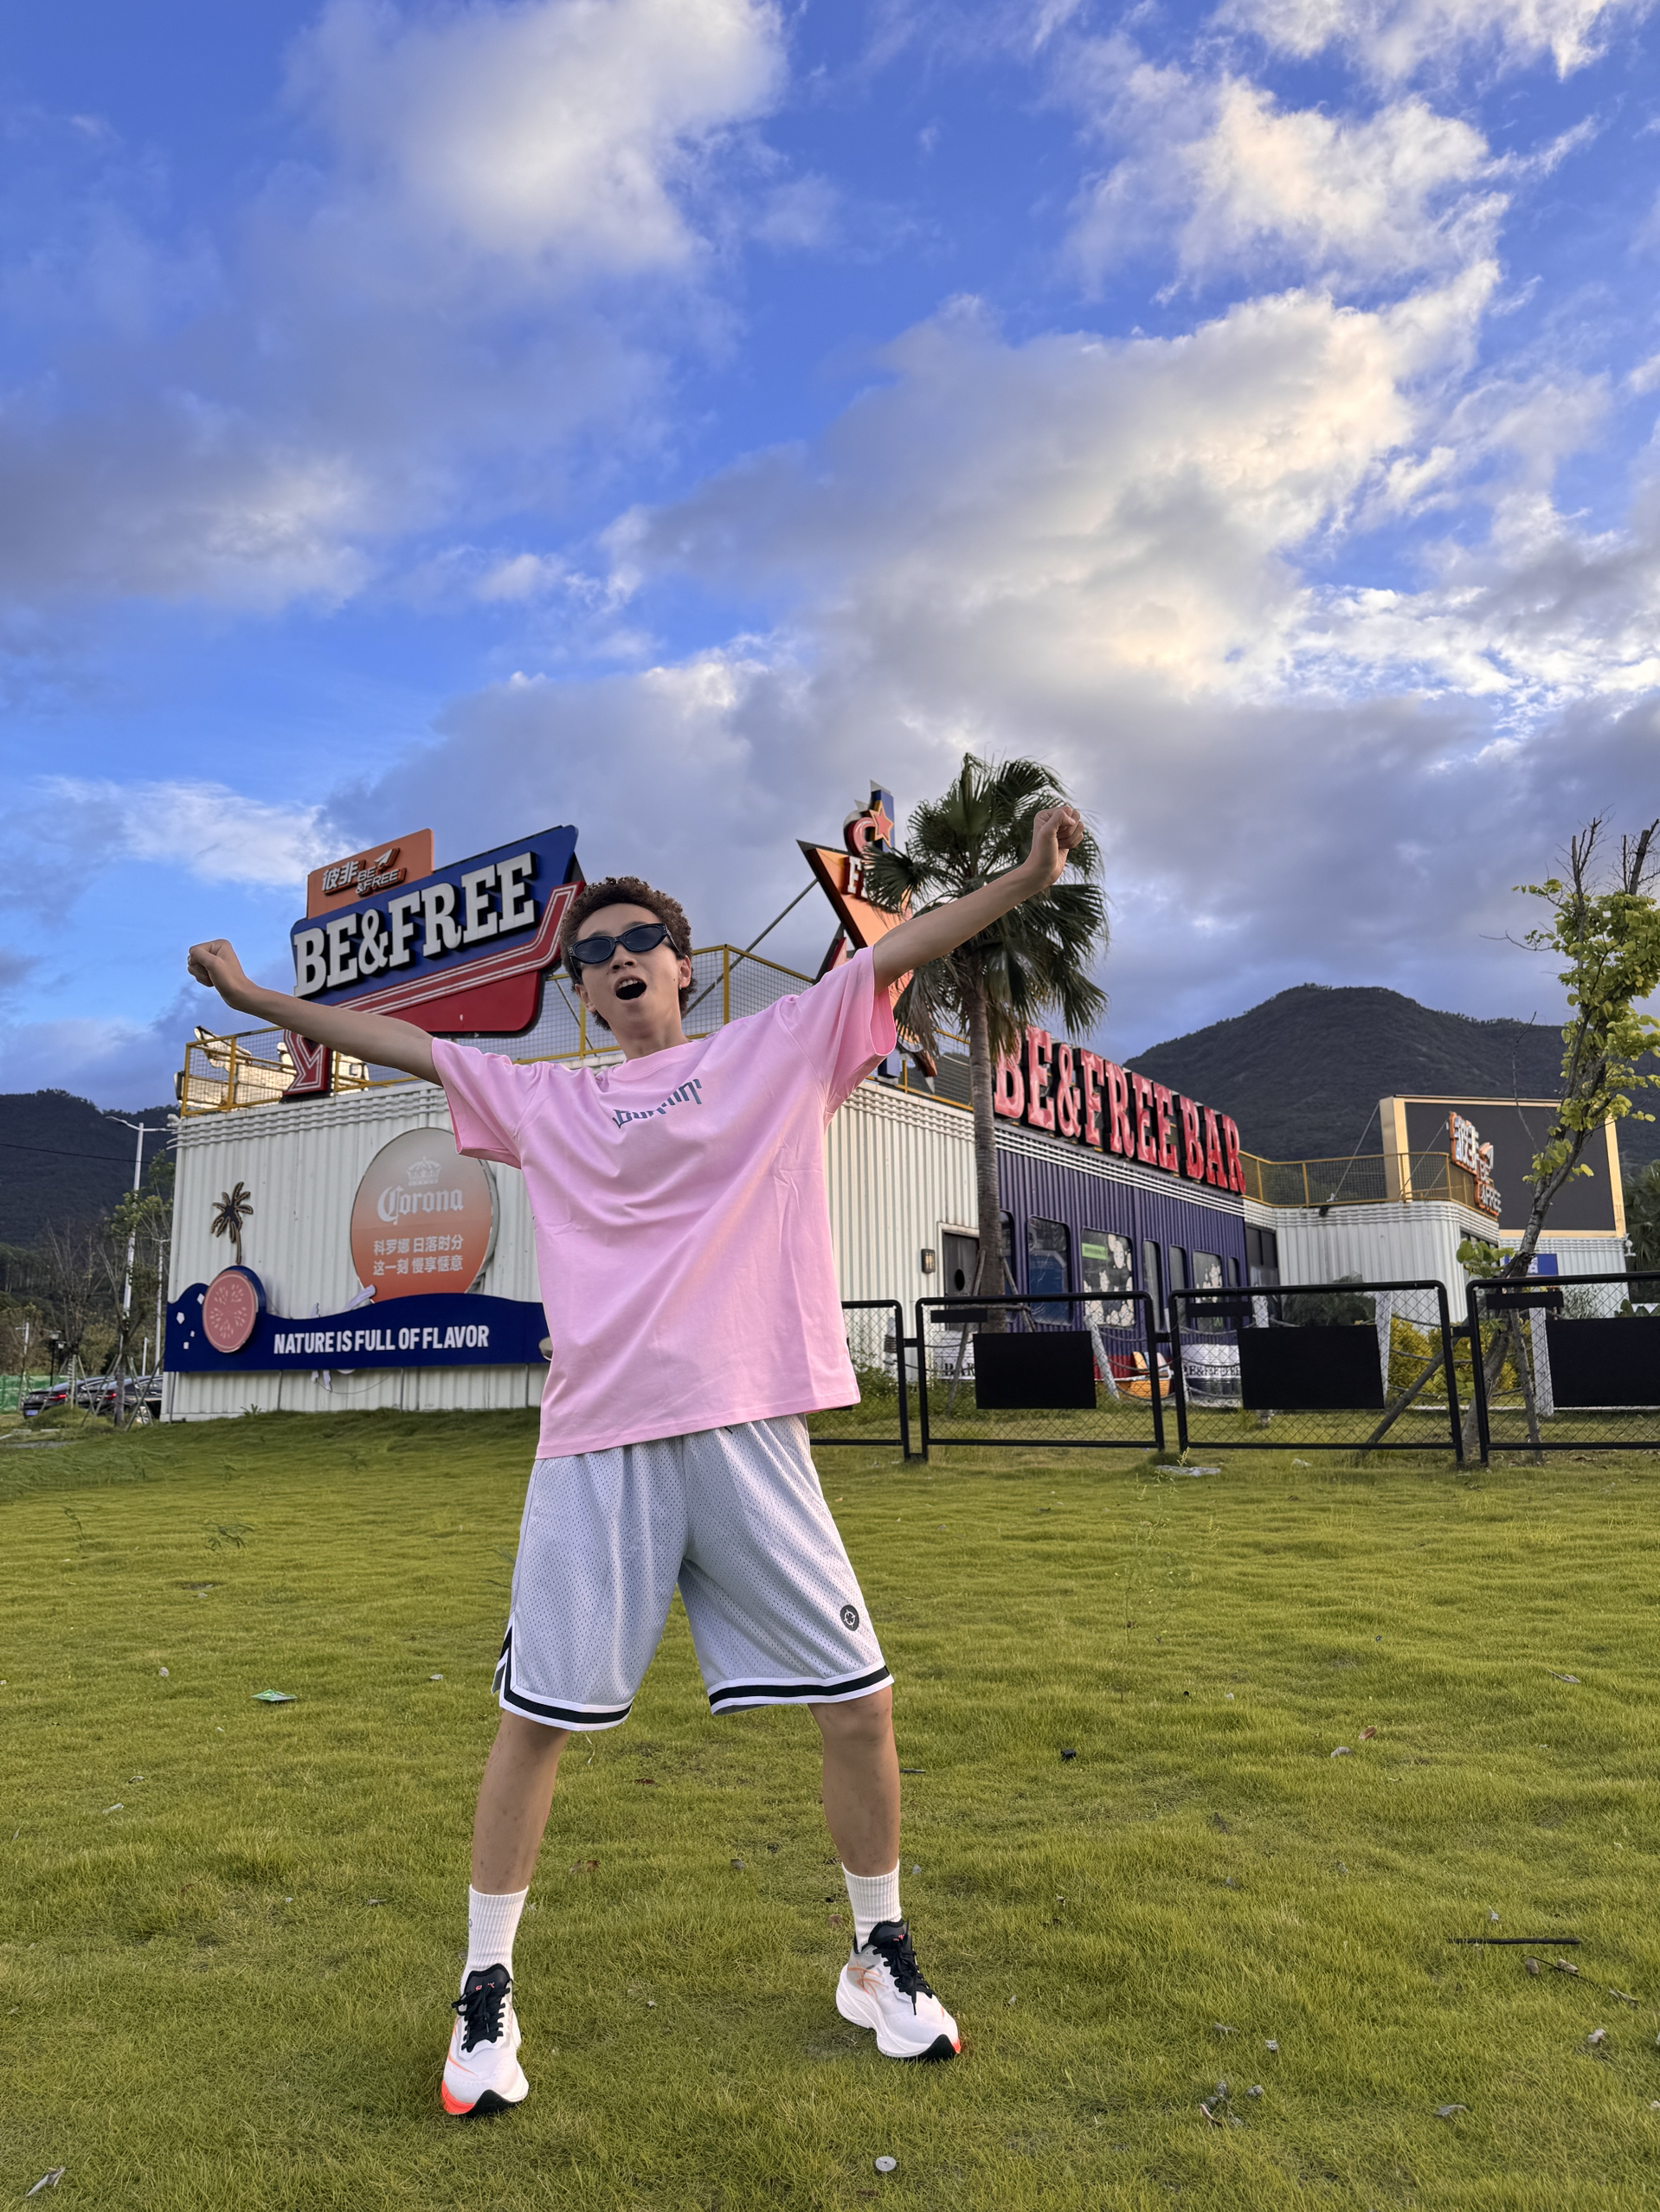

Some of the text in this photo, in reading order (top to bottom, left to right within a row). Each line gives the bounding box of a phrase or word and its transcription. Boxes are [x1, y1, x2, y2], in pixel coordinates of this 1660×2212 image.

[322, 860, 359, 891] 彼非
[356, 869, 400, 894] &FREE
[357, 866, 377, 882] BE
[293, 852, 536, 998] BE&FREE
[994, 1026, 1246, 1195] BE&FREE BAR
[376, 1185, 464, 1226] Corona
[373, 1234, 464, 1256] 科罗娜 日落时分
[373, 1257, 409, 1276] 这一刻
[273, 1325, 490, 1354] NATURE IS FULL OF FLAVOR
